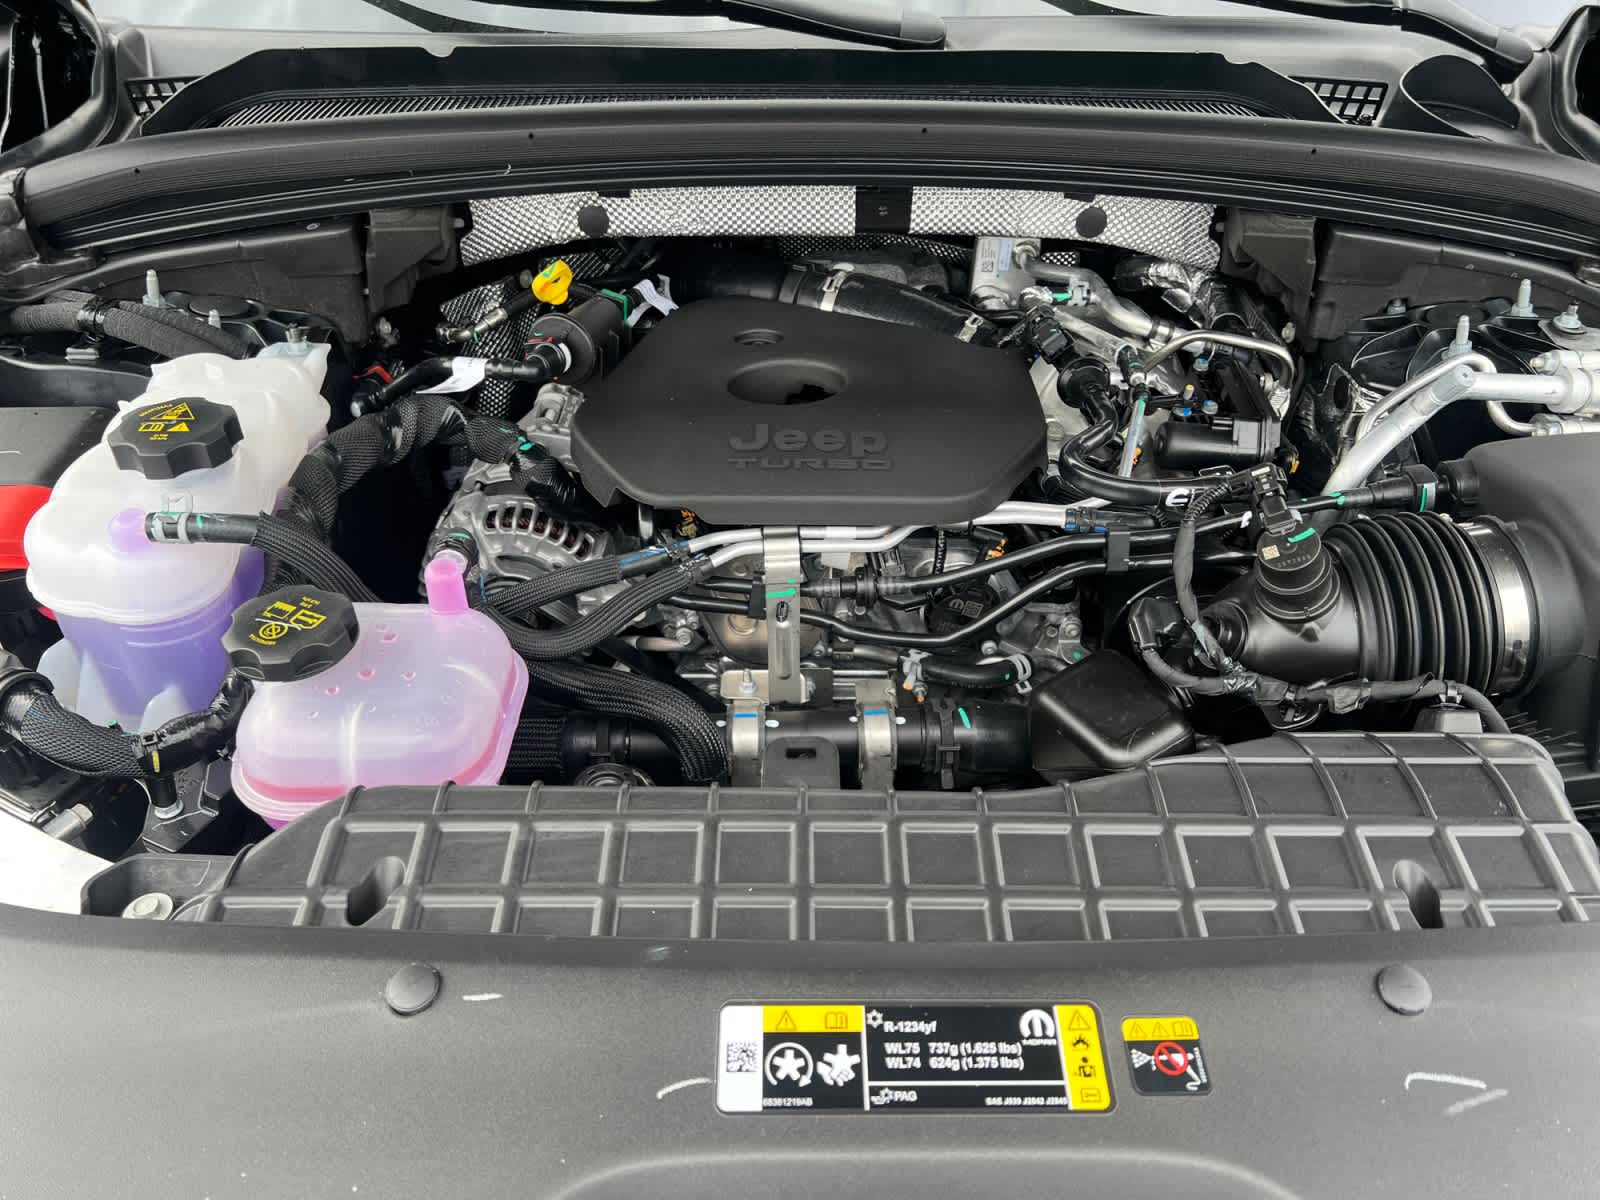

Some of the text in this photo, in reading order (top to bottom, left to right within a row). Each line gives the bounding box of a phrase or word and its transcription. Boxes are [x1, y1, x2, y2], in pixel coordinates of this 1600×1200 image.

[728, 424, 888, 456] Jeep
[728, 457, 892, 471] TURBO
[884, 1021, 937, 1035] R-1234yf
[884, 1042, 1023, 1056] WL75 737g (1.625 lbs)
[885, 1056, 1024, 1071] WL74 624g (1.375 lbs)
[894, 1090, 918, 1102] PAG
